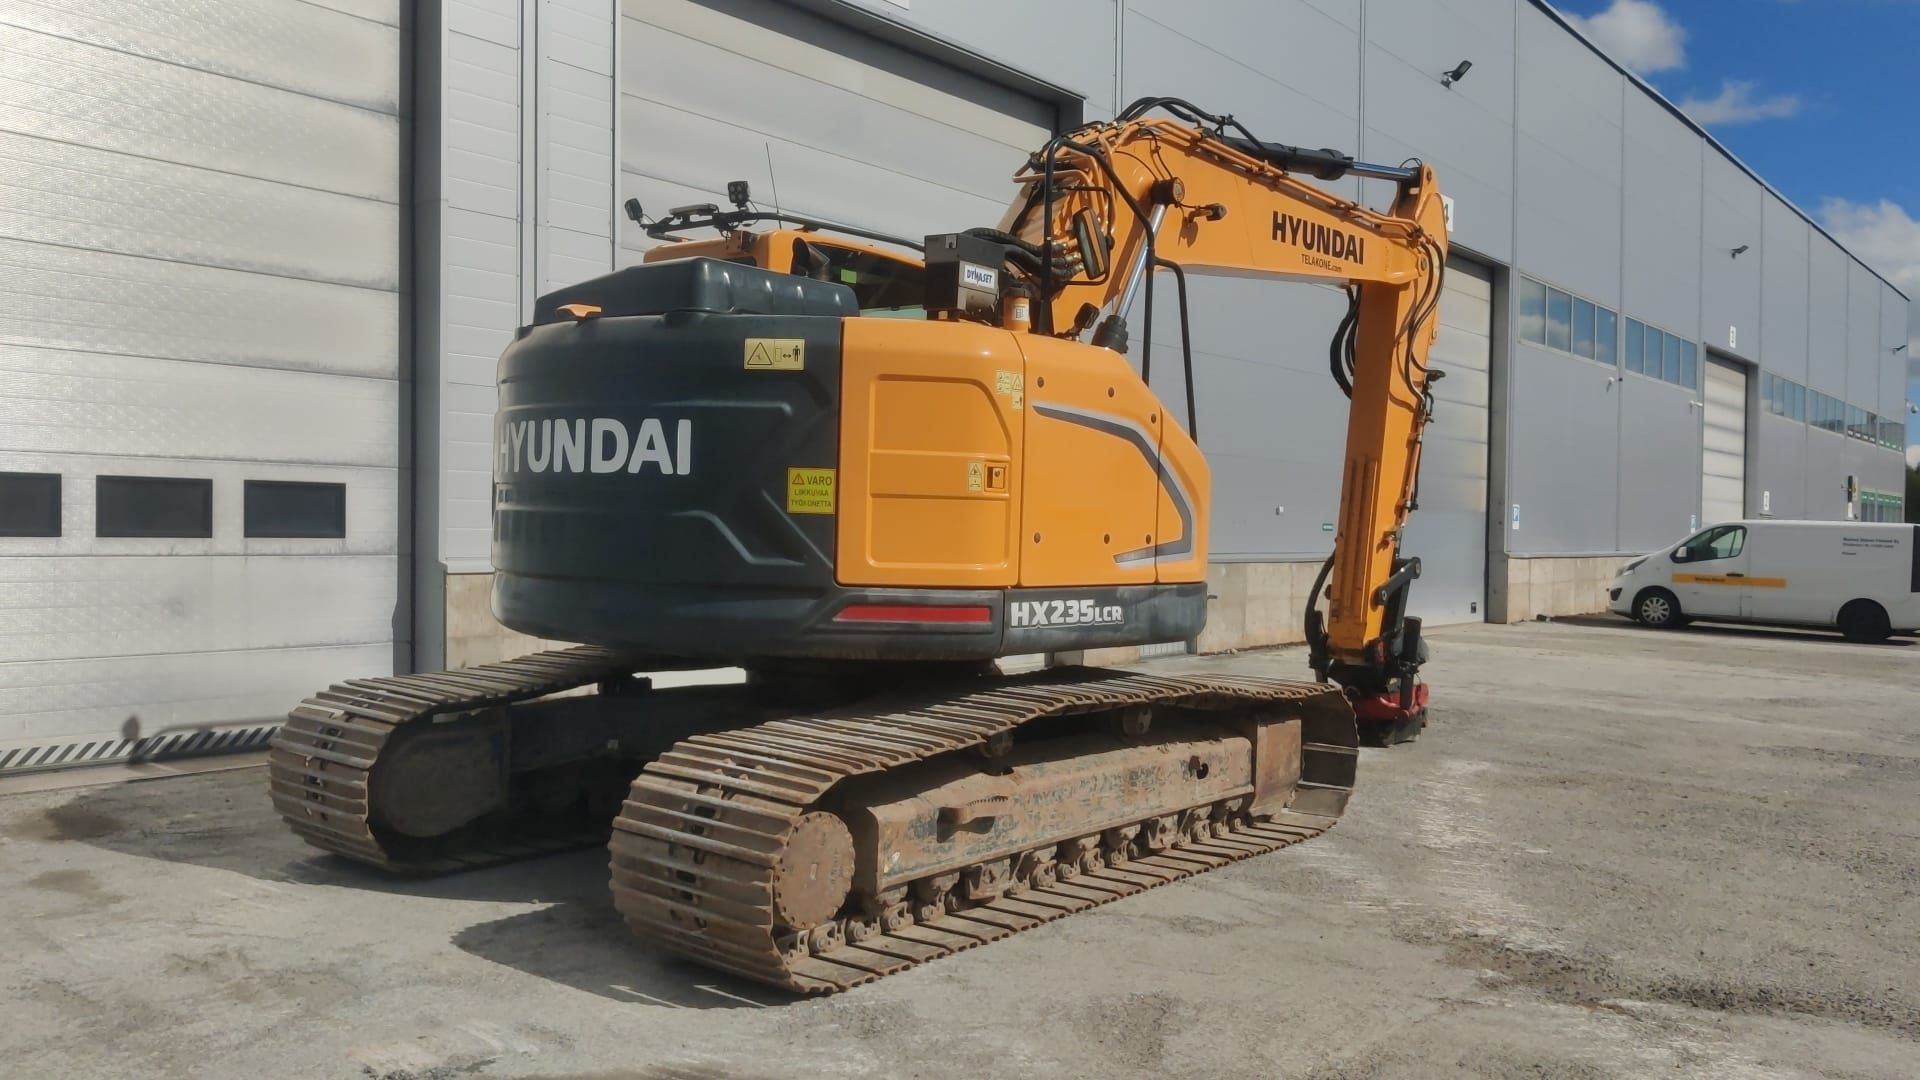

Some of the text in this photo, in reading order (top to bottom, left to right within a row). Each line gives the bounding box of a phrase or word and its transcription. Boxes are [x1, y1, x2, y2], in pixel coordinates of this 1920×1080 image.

[1272, 210, 1365, 265] HYUNDAI
[1301, 253, 1343, 273] TELAKONE.com
[498, 418, 692, 475] HYUNDAI
[807, 475, 833, 486] VARO
